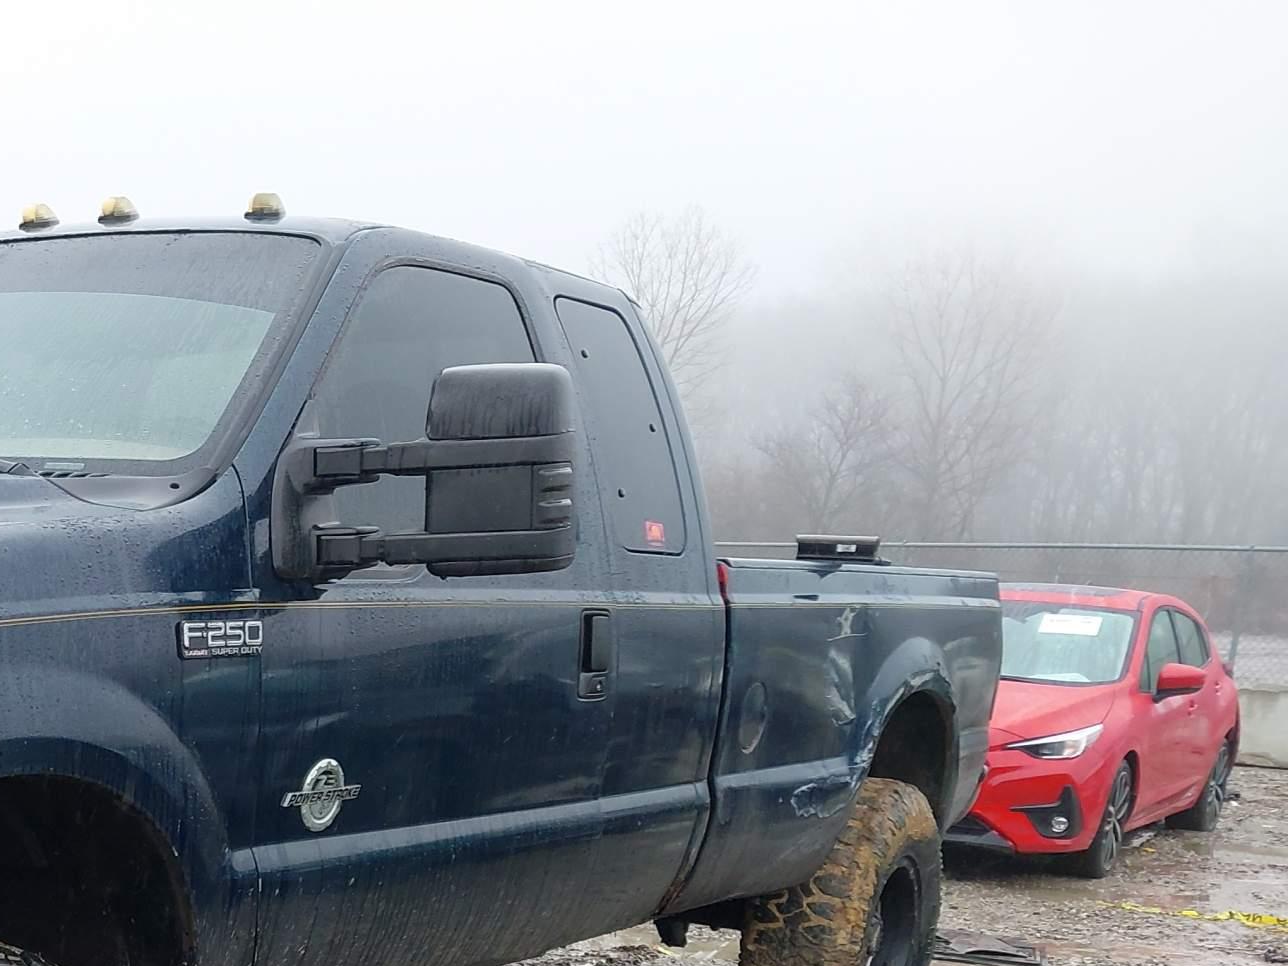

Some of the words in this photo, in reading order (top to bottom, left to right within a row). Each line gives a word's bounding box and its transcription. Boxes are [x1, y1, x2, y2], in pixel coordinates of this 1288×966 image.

[211, 647, 239, 656] SUPER
[240, 646, 263, 655] DUTY
[286, 790, 324, 806] POWER
[324, 785, 361, 801] STROKE
